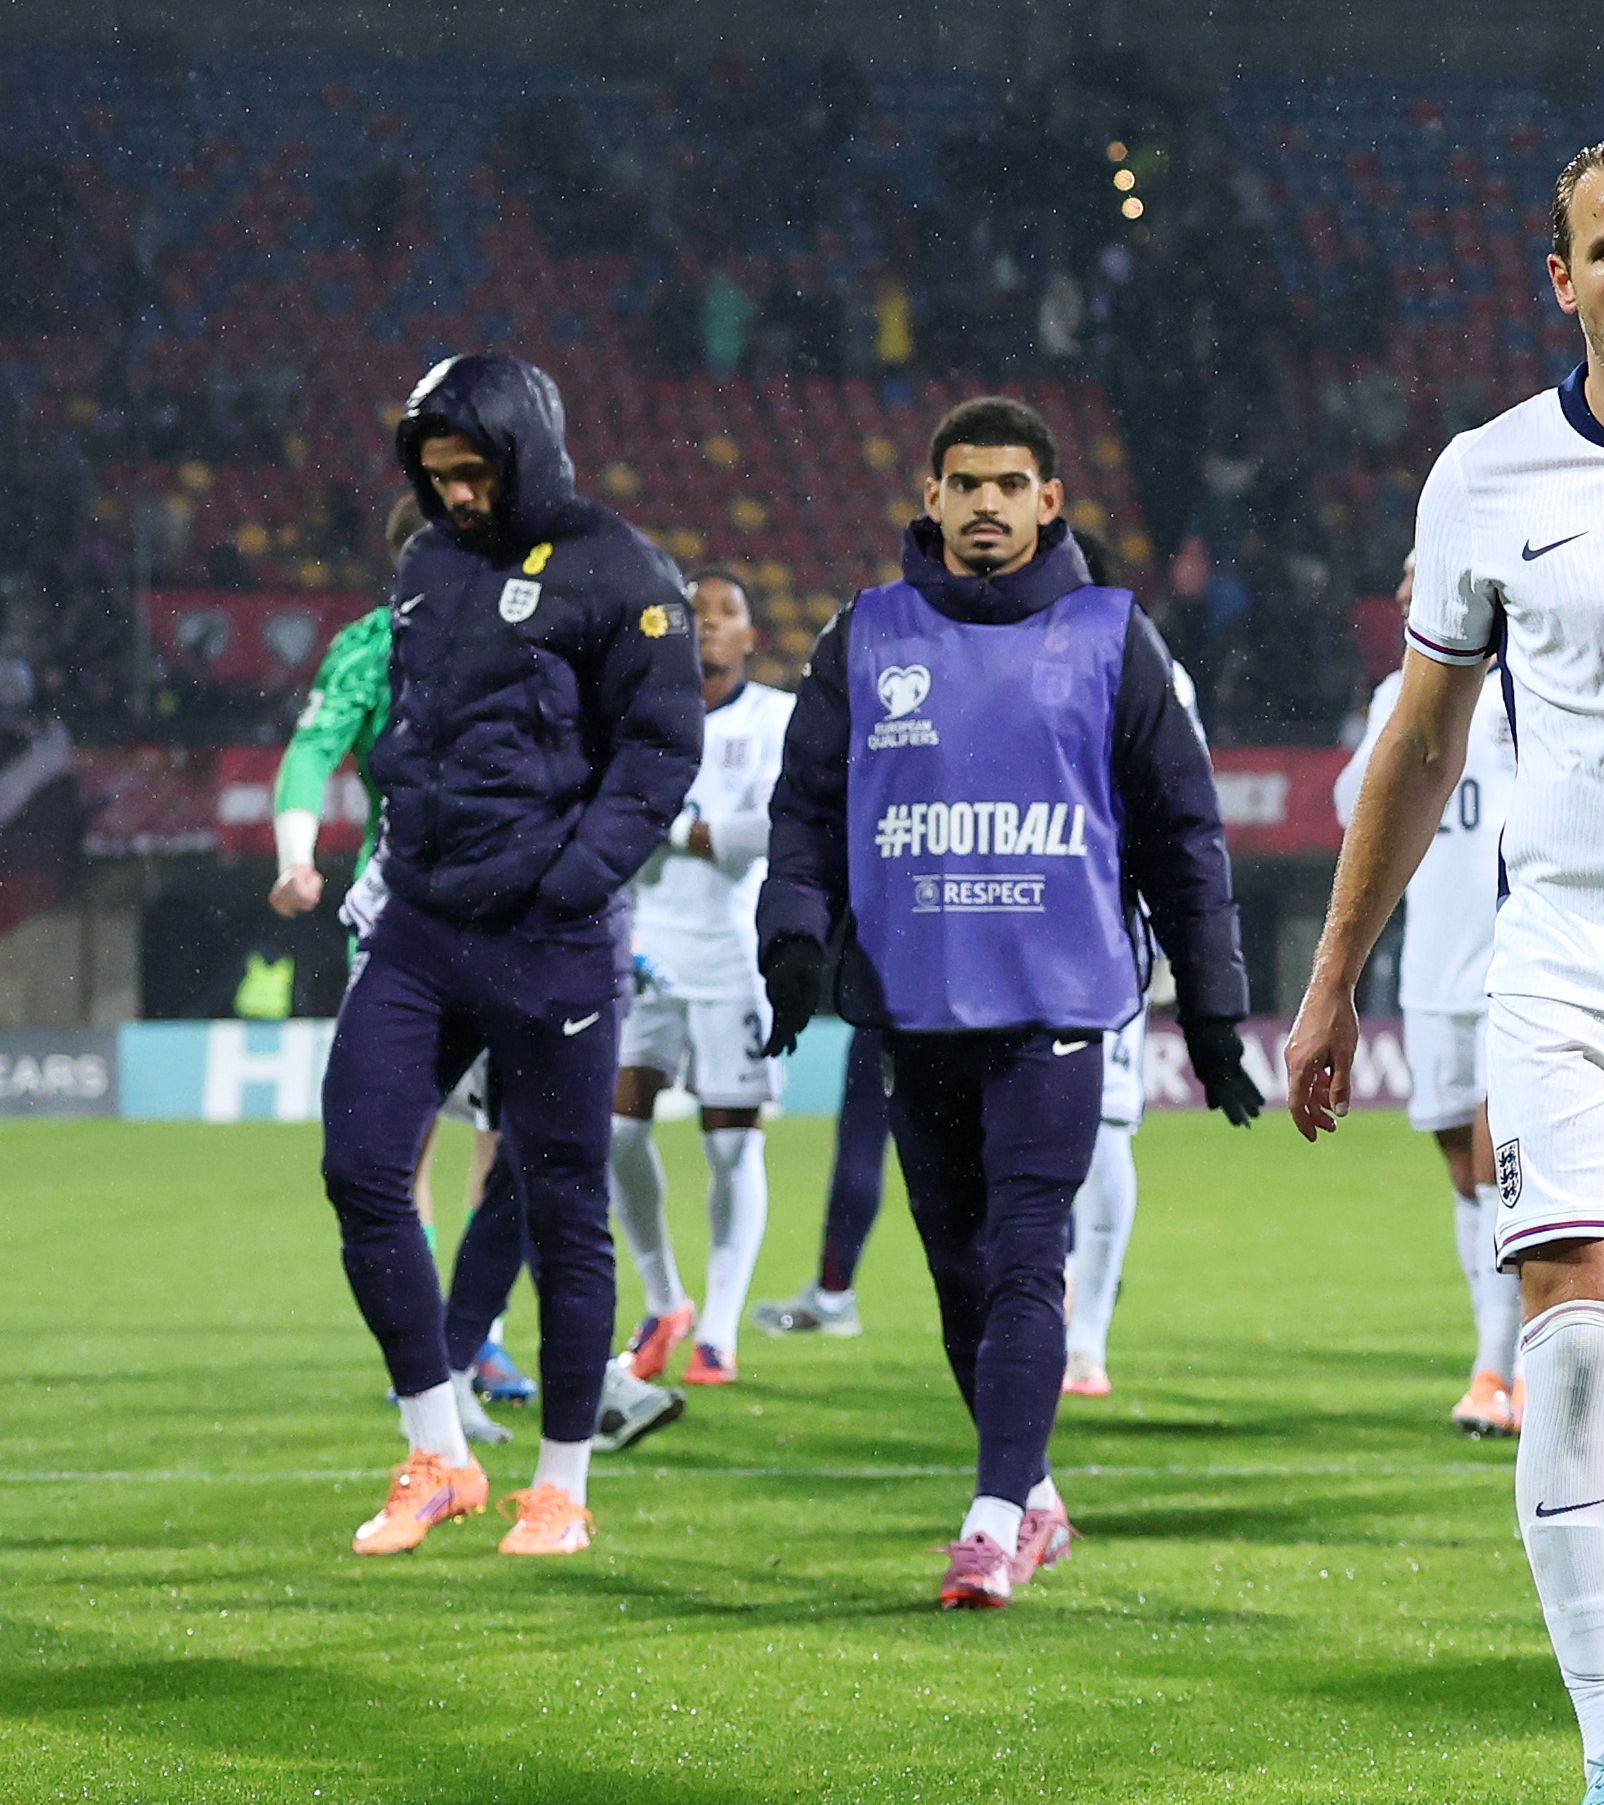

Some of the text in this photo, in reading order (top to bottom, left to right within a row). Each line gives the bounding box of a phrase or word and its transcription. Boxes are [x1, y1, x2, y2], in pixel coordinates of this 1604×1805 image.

[875, 801, 1088, 858] #FOOTBALL
[944, 881, 1045, 905] RESPECT
[203, 1020, 338, 1123] H
